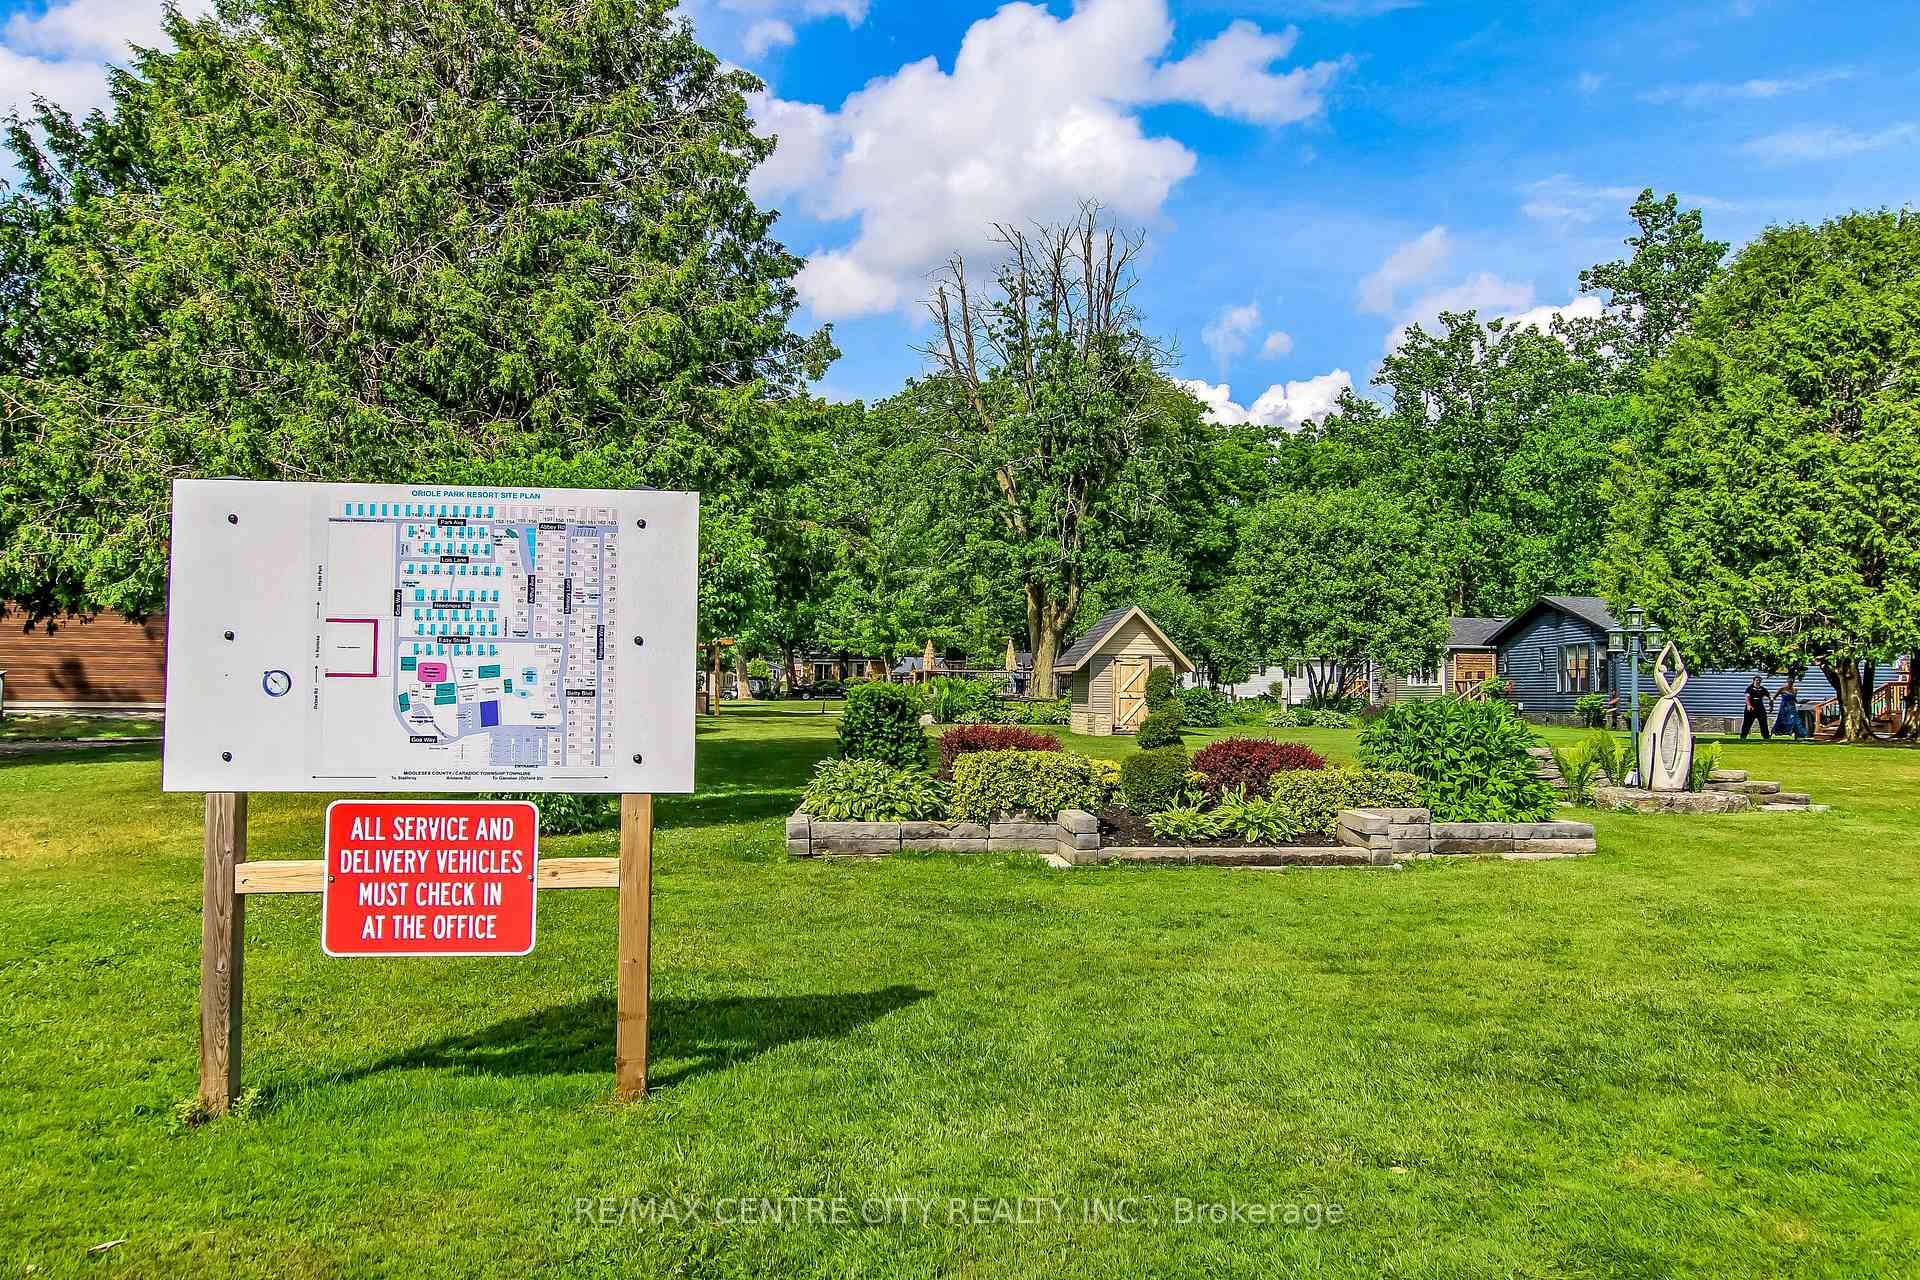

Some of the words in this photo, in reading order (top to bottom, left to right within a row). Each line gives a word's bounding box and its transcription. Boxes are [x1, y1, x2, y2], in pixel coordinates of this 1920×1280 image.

[411, 489, 441, 498] ORIOLE
[443, 490, 465, 498] PARK
[466, 491, 499, 499] RESORT
[500, 491, 518, 499] SITE
[519, 492, 541, 500] PLAN
[350, 816, 386, 841] ALL
[393, 816, 469, 842] SERVICE
[475, 817, 514, 841] AND
[339, 849, 430, 874] DELIVERY
[436, 849, 523, 874] VEHICLES
[358, 881, 409, 907] MUST
[415, 881, 475, 907] CHECK
[483, 882, 502, 906] IN
[360, 914, 386, 939] AT
[392, 914, 427, 940] THE
[432, 914, 497, 940] OFFICE
